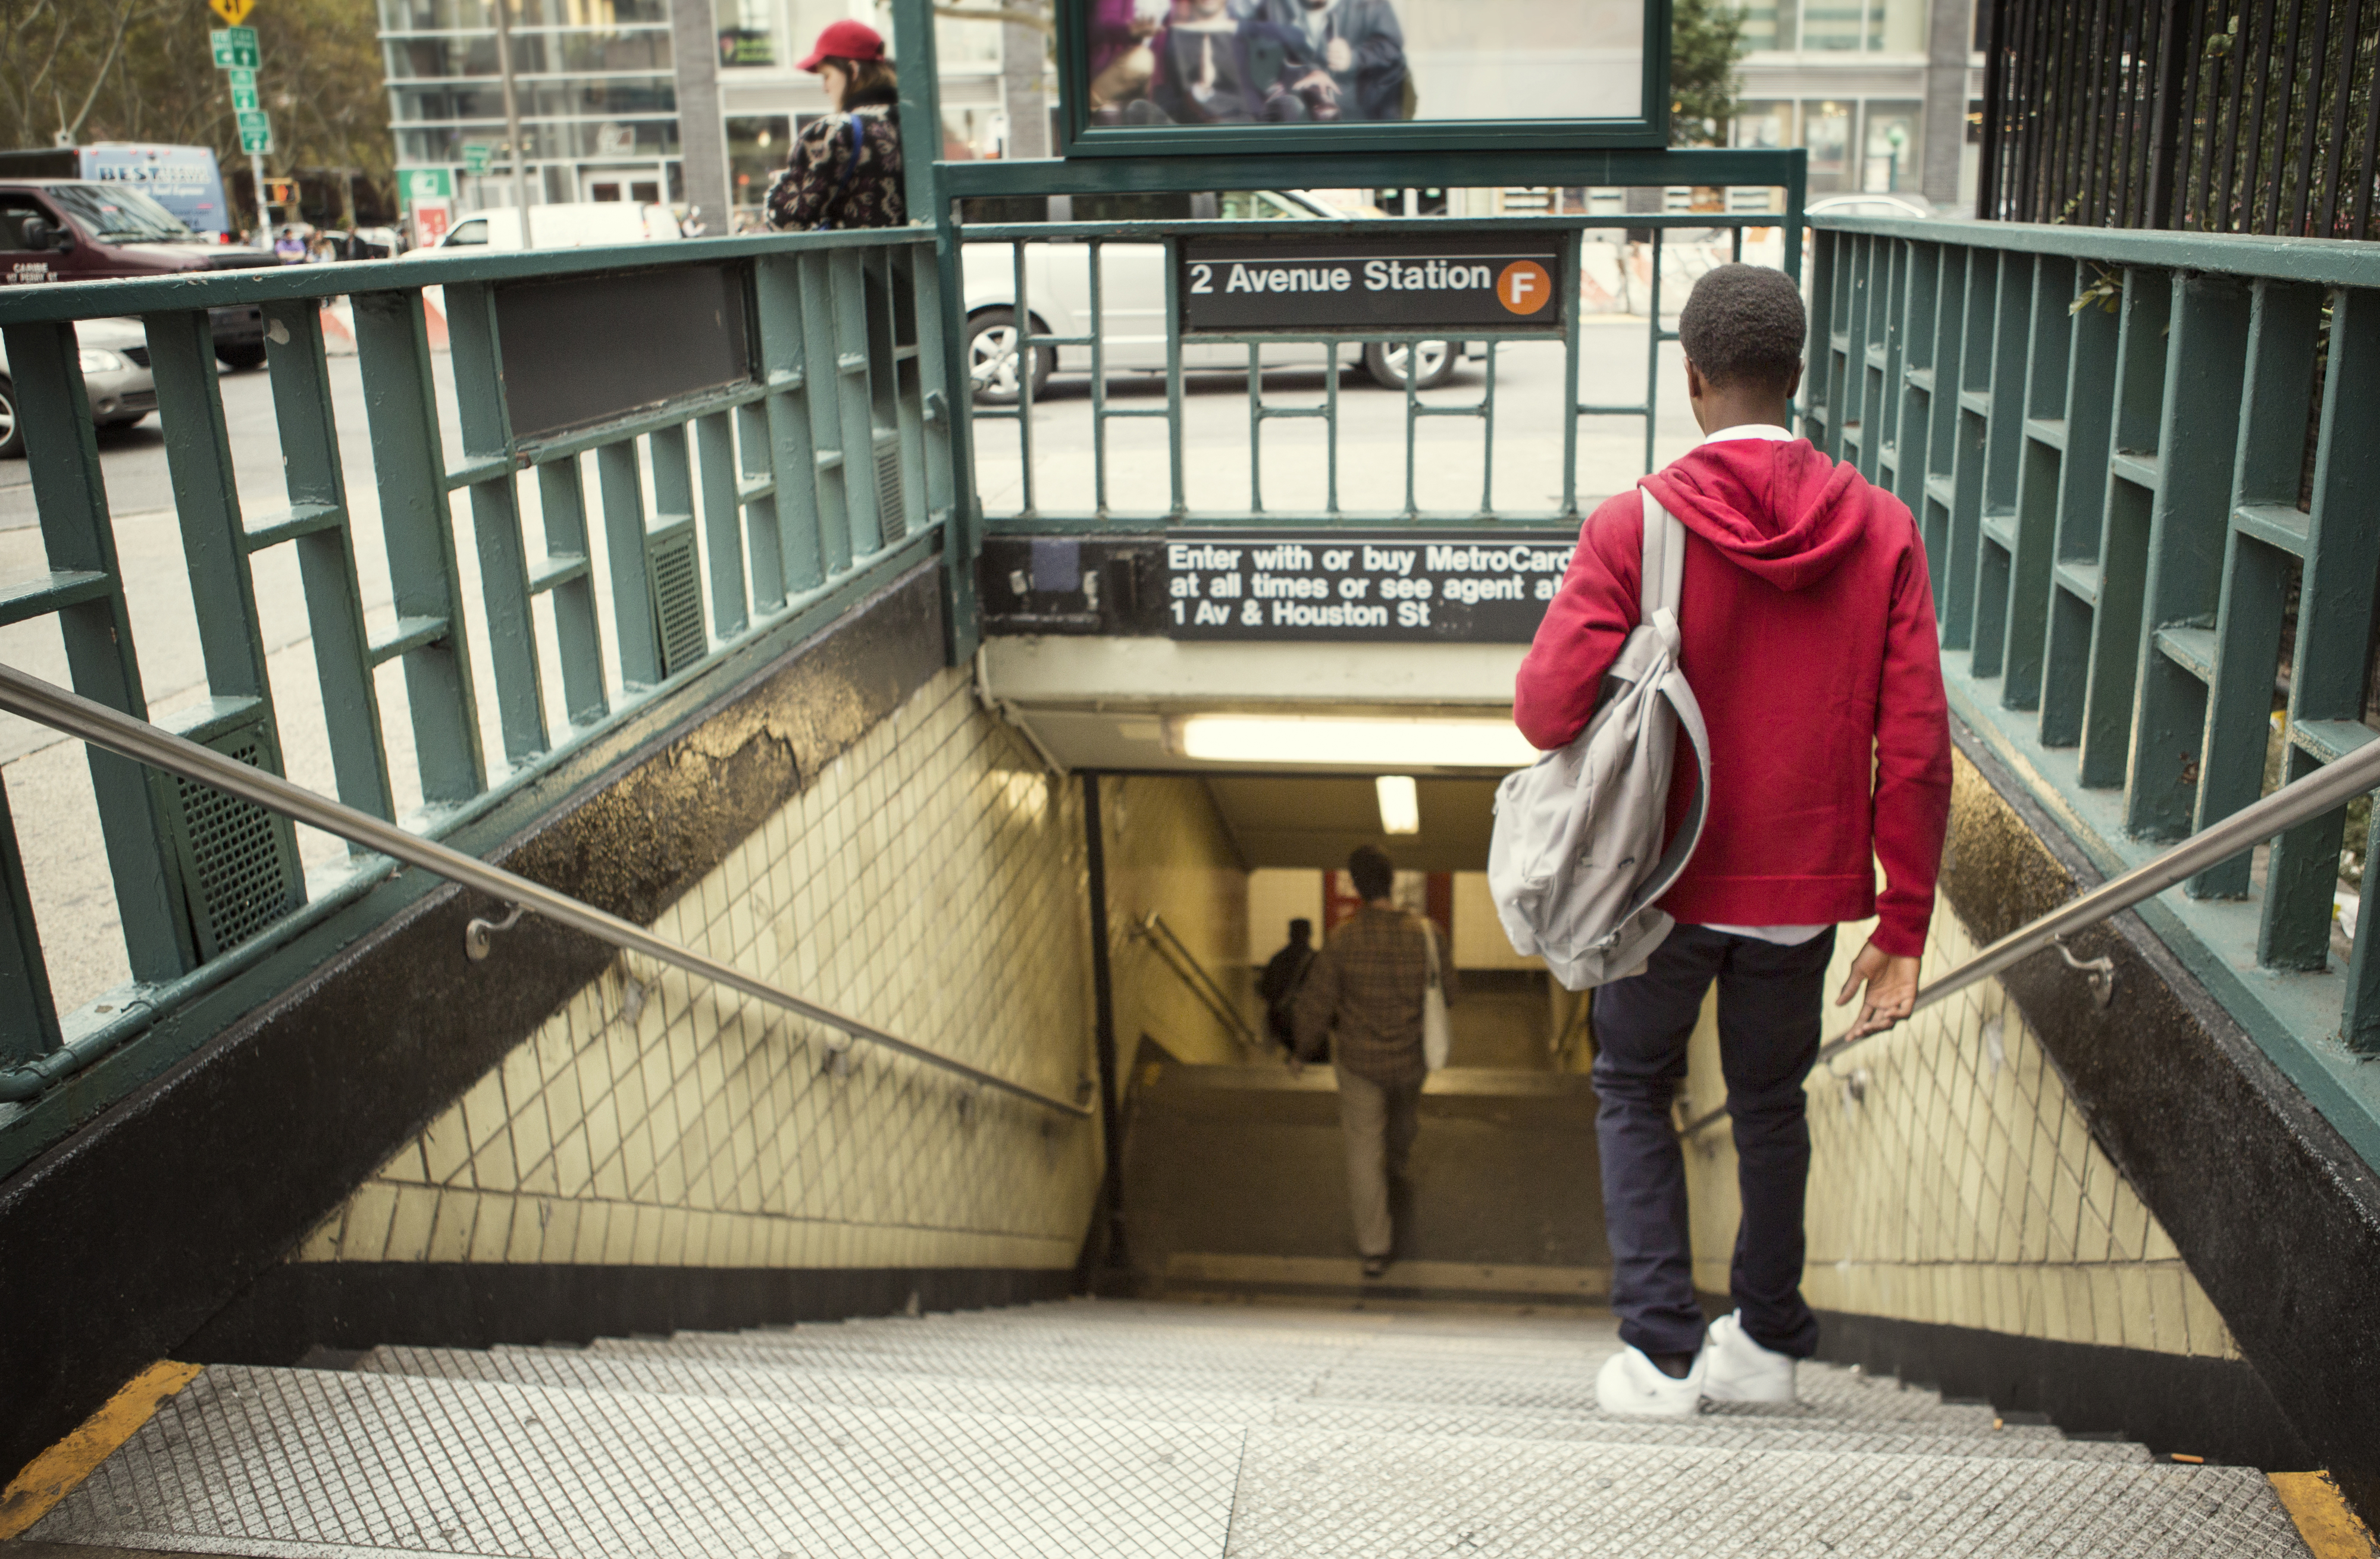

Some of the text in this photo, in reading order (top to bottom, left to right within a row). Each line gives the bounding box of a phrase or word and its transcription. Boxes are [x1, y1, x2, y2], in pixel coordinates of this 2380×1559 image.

[1190, 261, 1536, 304] 2 Avenue Station F
[1168, 545, 1242, 570] Enter
[1252, 545, 1314, 570] with
[1321, 549, 1354, 571] or
[1363, 545, 1416, 576] buy
[1170, 572, 1200, 597] at
[1210, 572, 1242, 598] all
[1251, 572, 1329, 598] times
[1338, 578, 1370, 598] or
[1379, 578, 1433, 599] see
[1442, 574, 1524, 604] agent
[1170, 598, 1431, 626] 1 Av & Houston St
